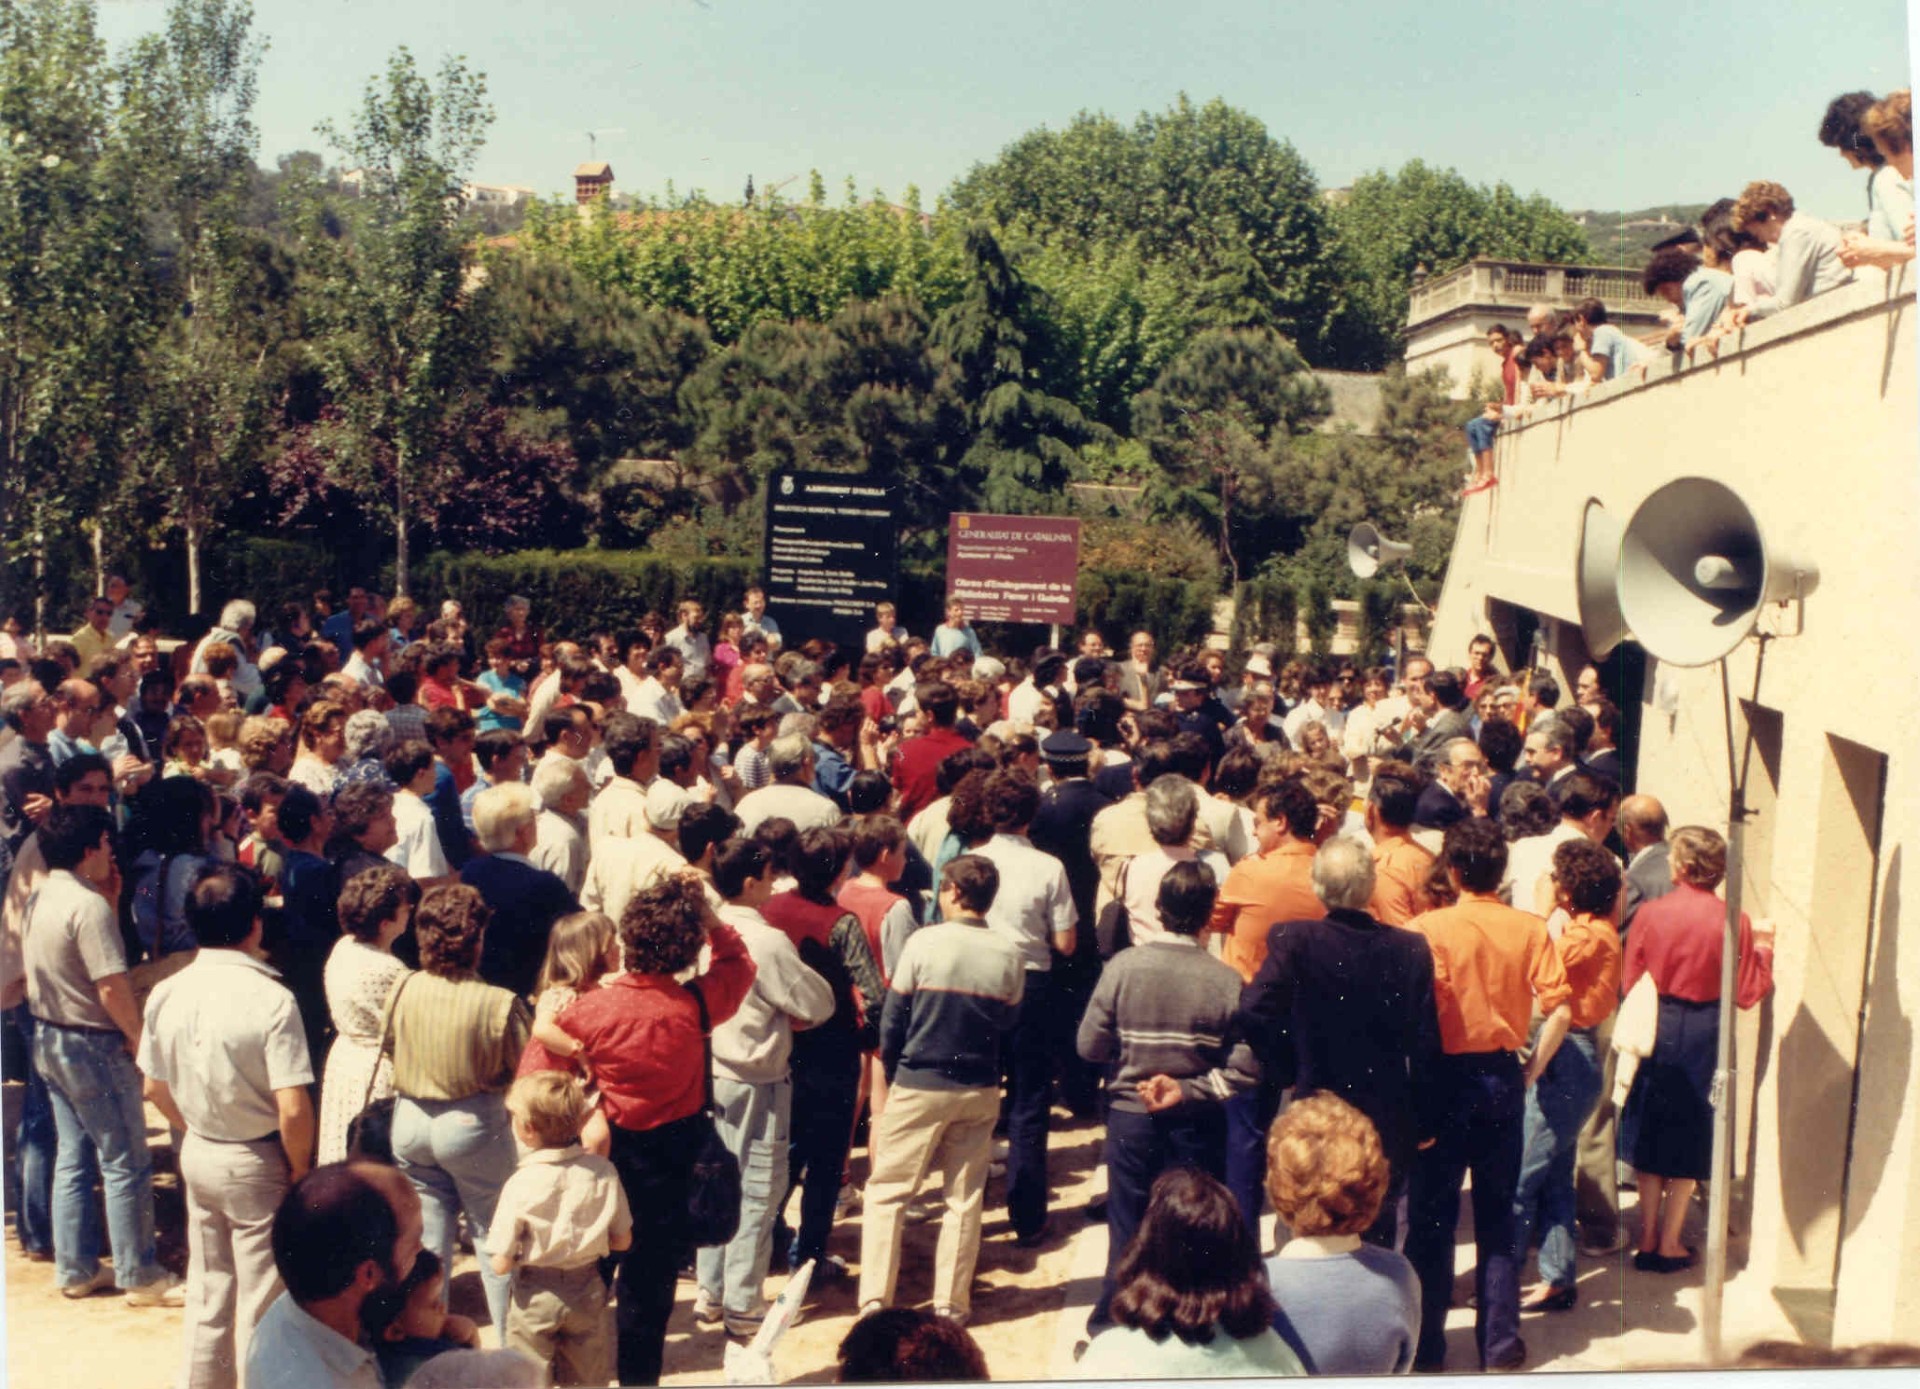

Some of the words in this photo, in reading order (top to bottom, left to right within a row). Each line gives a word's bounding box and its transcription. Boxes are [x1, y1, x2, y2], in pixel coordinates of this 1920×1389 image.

[958, 530, 1010, 540] GENERALITAT
[1011, 531, 1022, 540] DE
[1024, 532, 1073, 542] CATALUNYA
